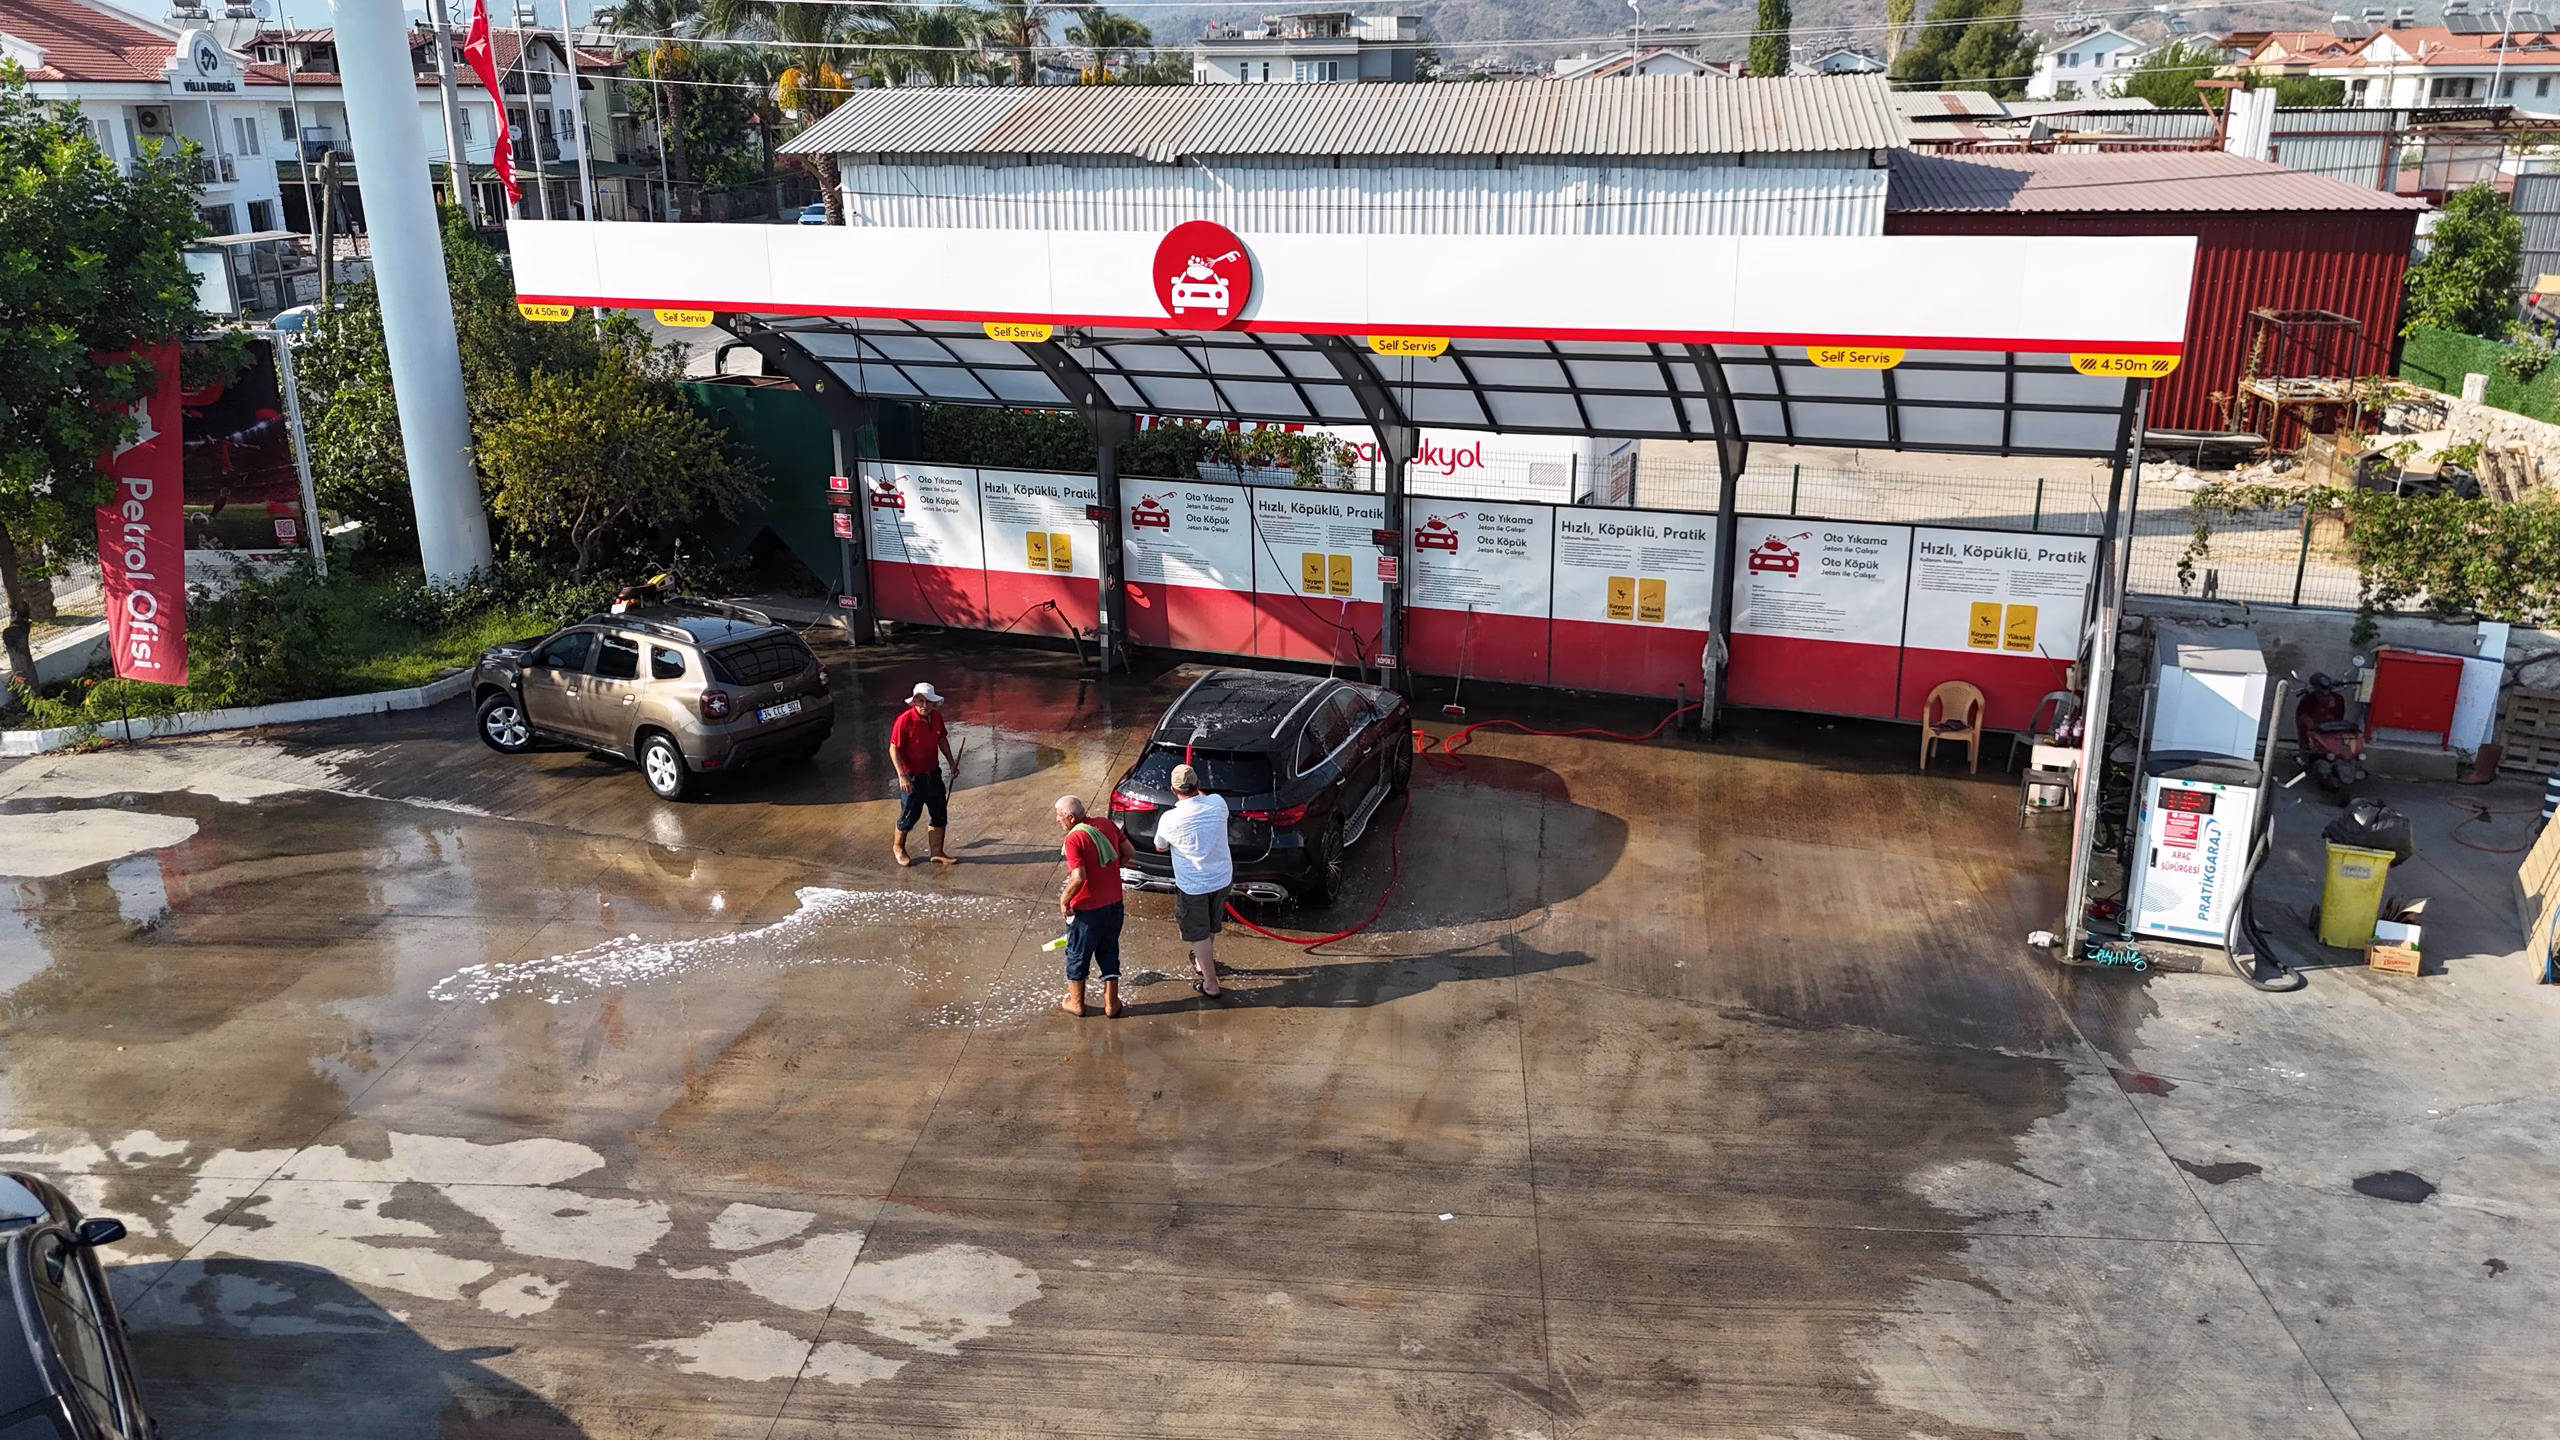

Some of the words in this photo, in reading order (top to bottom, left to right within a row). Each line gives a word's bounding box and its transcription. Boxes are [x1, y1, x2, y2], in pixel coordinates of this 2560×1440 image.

[534, 307, 559, 317] 4.50m
[663, 312, 678, 322] Self
[680, 313, 707, 323] Servis
[993, 326, 1012, 337] Self
[1013, 326, 1044, 338] Servis
[1379, 339, 1400, 351] Self
[1402, 340, 1437, 352] Servis
[1820, 350, 1846, 363] Self
[1849, 351, 1890, 364] Servis
[2100, 358, 2147, 371] 4.50m
[918, 475, 932, 484] Oto
[934, 476, 962, 486] Yıkama
[984, 481, 1011, 495] Hızlı,
[1013, 483, 1061, 499] Köpüklü,
[1063, 487, 1097, 500] Pratik
[920, 495, 934, 504] Oto
[936, 496, 960, 507] Köpük
[1185, 492, 1201, 501] Oto
[1203, 493, 1234, 504] Yıkama
[1258, 500, 1287, 514] Hızlı,
[1291, 501, 1343, 518] Köpüklü,
[1346, 506, 1384, 520] Pratik
[1186, 513, 1201, 523] Oto
[1203, 514, 1230, 526] Köpük
[1477, 512, 1496, 522] Oto
[1498, 514, 1533, 525] Yıkama
[121, 477, 156, 580] Petrol
[1561, 520, 1594, 536] Hızlı,
[1598, 522, 1658, 540] Köpüklü,
[1663, 527, 1706, 541] Pratik
[1477, 535, 1495, 545] Oto
[1497, 536, 1527, 548] Köpük
[1823, 532, 1844, 543] Oto
[1847, 534, 1888, 545] Yıkama
[1822, 544, 1843, 552] Jeton
[1855, 546, 1879, 555] Çalışır
[1920, 541, 1957, 558] Hızlı,
[1962, 544, 2032, 563] Köpüklü,
[2037, 548, 2087, 564] Pratik
[1821, 557, 1842, 567] Oto
[1844, 558, 1879, 571] Köpük
[1820, 569, 1841, 577] Jeton
[1852, 571, 1877, 580] Çalışır
[126, 589, 161, 670] Ofisi
[1970, 630, 1997, 639] Kaygan
[2007, 633, 2032, 641] Yüksek
[762, 709, 772, 719] 34
[772, 704, 786, 716] CCC
[2172, 851, 2191, 861] ARAÇ
[2160, 861, 2200, 874] SÜPÜRGESİ
[2197, 828, 2222, 922] PRATİKGARAJ
